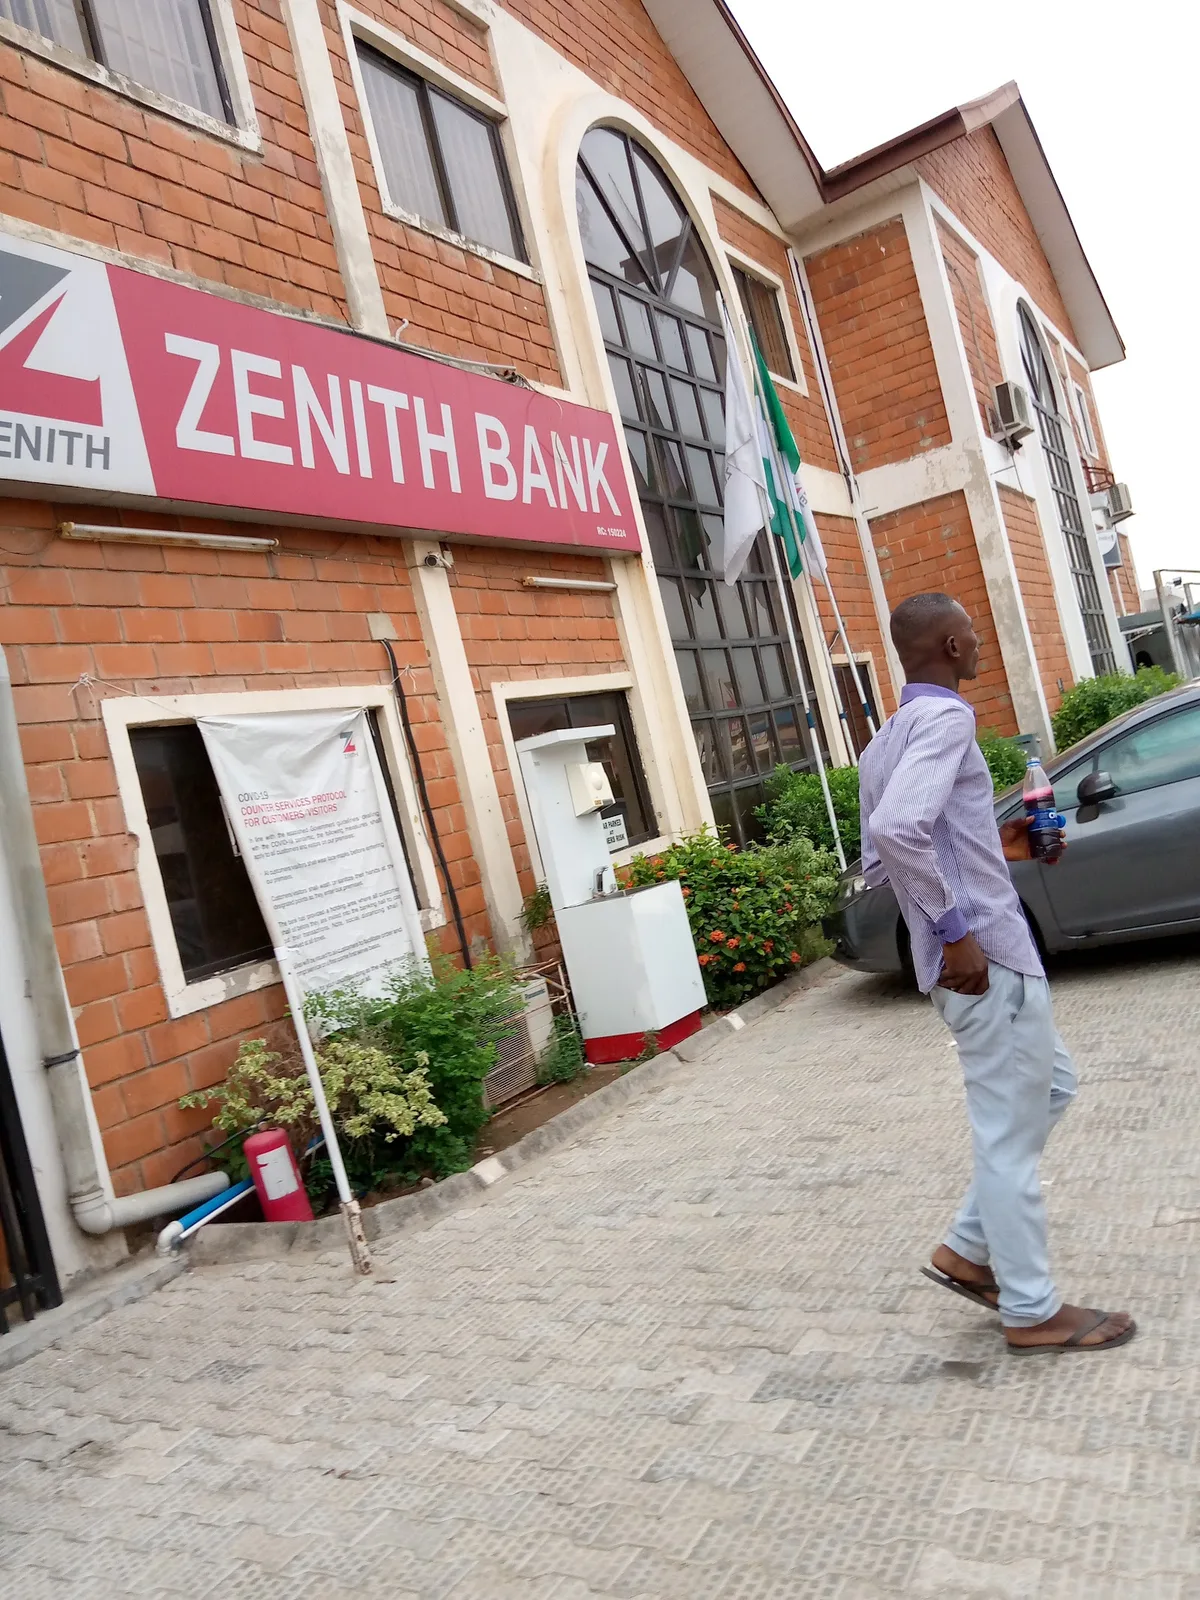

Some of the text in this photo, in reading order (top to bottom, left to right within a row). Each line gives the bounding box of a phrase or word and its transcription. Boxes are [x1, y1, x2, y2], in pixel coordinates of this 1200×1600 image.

[164, 332, 622, 517] ZENITH BANK
[238, 790, 269, 802] COVID-19
[241, 790, 347, 815] COUNTER SERVICES PROTOCOL
[244, 817, 260, 828] FOR
